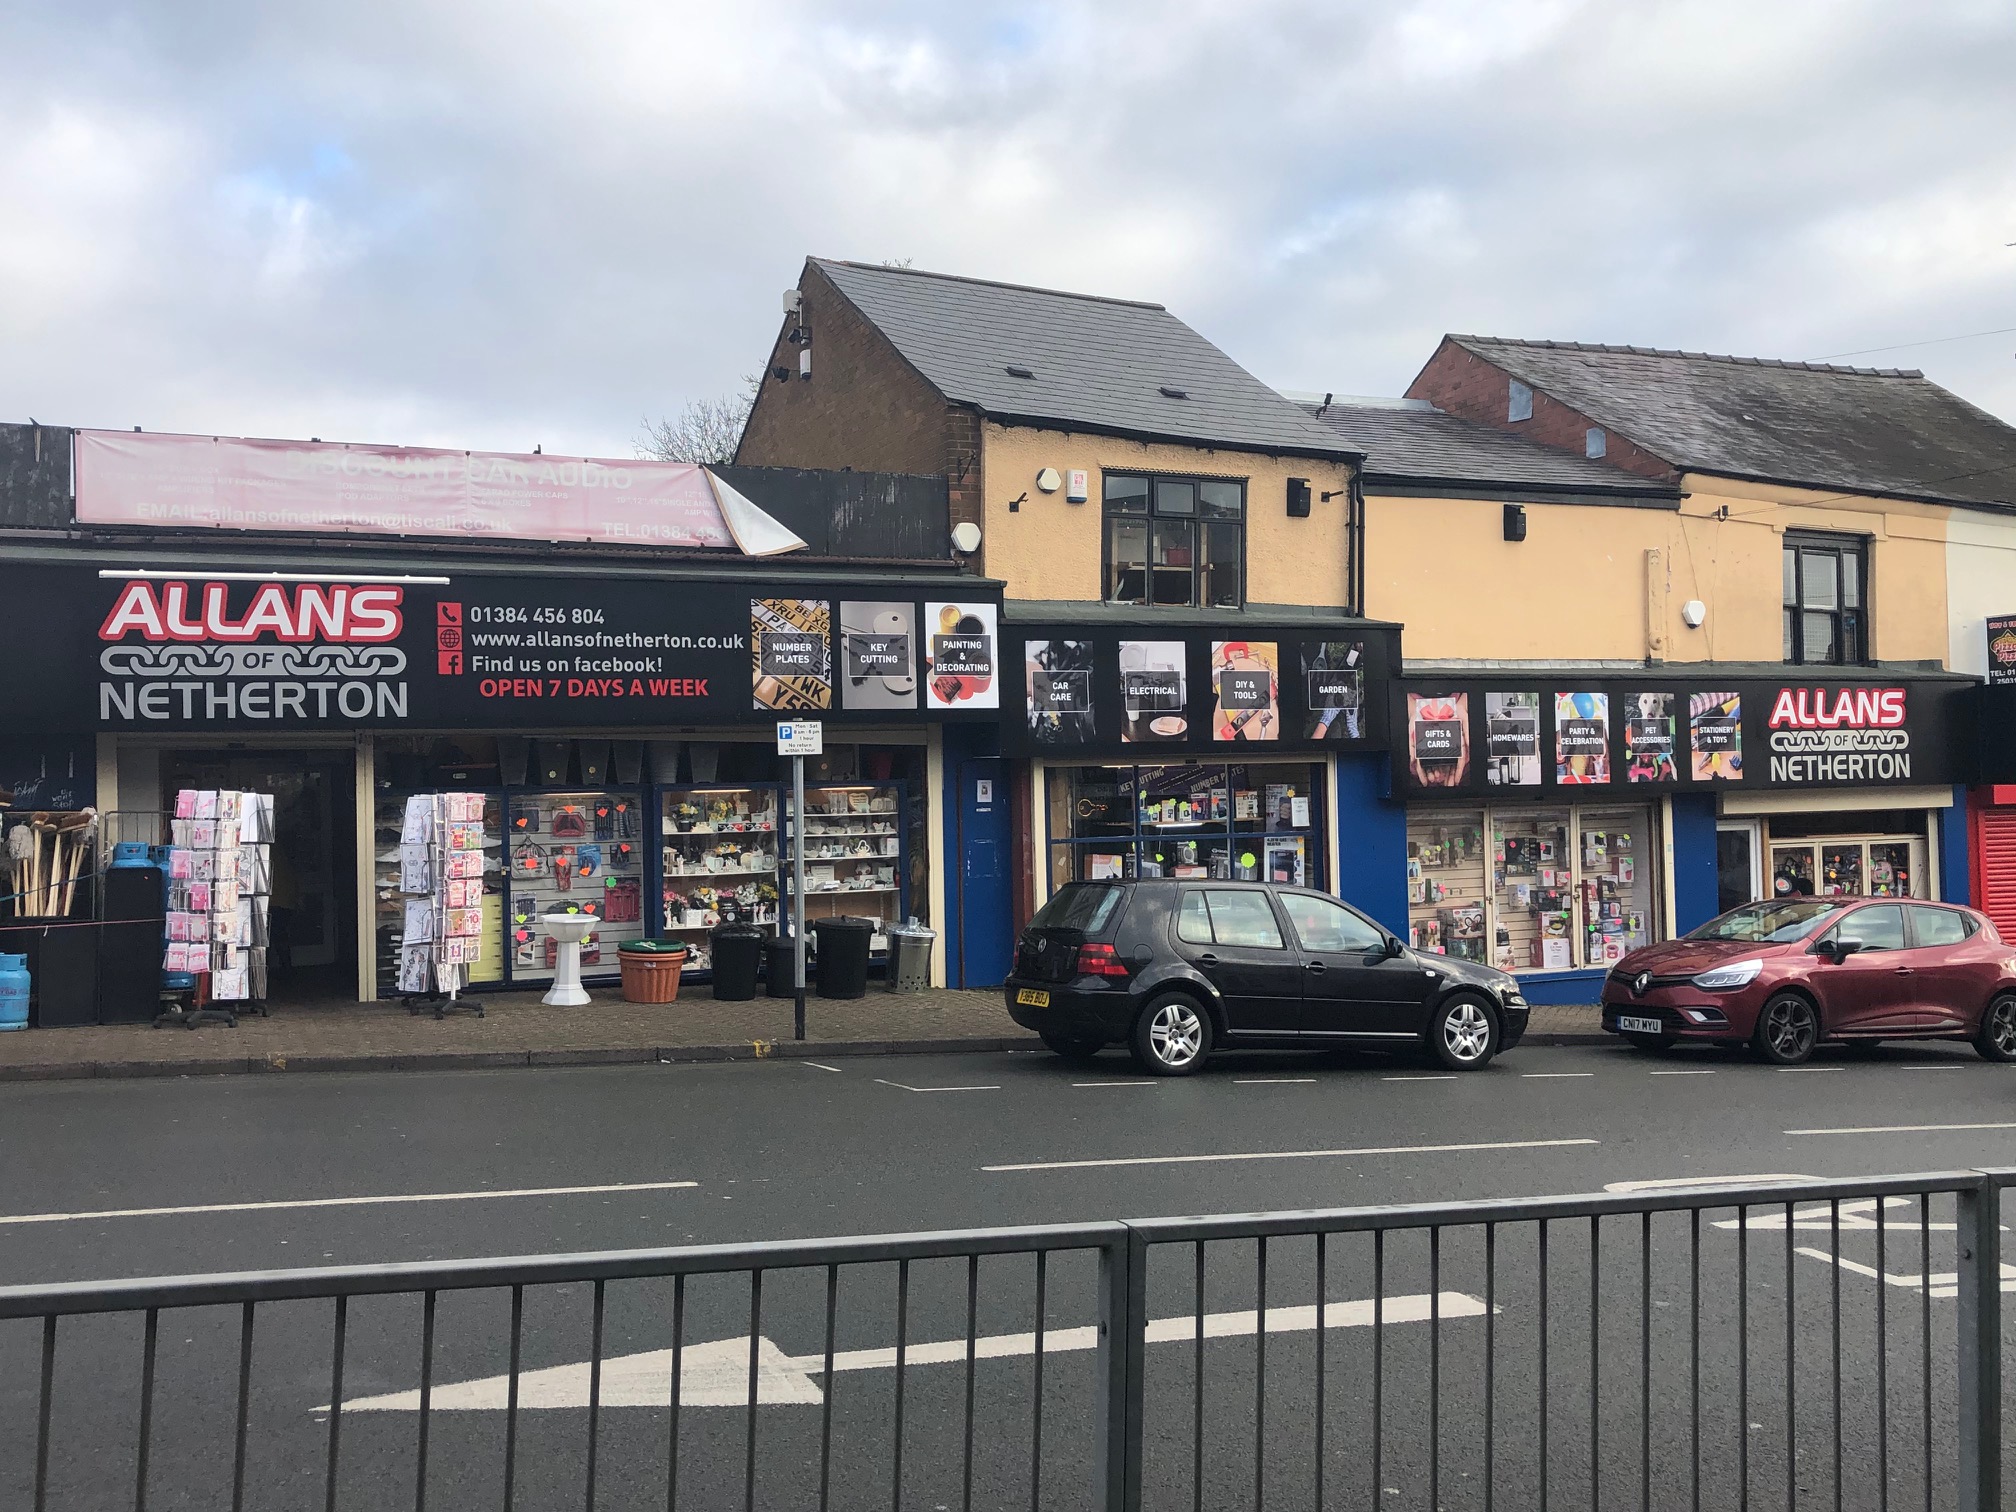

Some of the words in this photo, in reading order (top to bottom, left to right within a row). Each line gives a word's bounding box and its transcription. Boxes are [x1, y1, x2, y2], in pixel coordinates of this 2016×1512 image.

[468, 457, 529, 486] CAR
[538, 461, 633, 490] AUDIO
[545, 491, 570, 501] CAPS
[99, 581, 403, 642] ALLANS
[470, 606, 528, 623] 01384
[533, 607, 566, 624] 456
[572, 607, 605, 625] 804
[471, 631, 745, 650] www.allansofnetherton.co.uk
[942, 640, 982, 649] PAINTING
[772, 642, 812, 652] NUMBER
[870, 643, 888, 652] KEY
[242, 652, 275, 669] OF
[775, 654, 810, 664] PLATES
[860, 654, 898, 664] CUTTING
[959, 652, 966, 660] &
[472, 655, 514, 672] Find
[519, 660, 541, 672] us
[546, 660, 569, 673] on
[574, 656, 663, 673] facebook!
[936, 663, 990, 672] DECORATING
[479, 678, 542, 697] OPEN
[549, 679, 561, 696] 7
[568, 679, 624, 697] DAYS
[630, 679, 644, 696] A
[648, 679, 709, 696] WEEK
[1052, 681, 1069, 690] CAR
[1235, 681, 1247, 689] DIY
[1249, 681, 1255, 689] &
[1319, 686, 1348, 694] GARDEN
[1129, 686, 1178, 695] ELECTRICAL
[1233, 691, 1257, 699] TOOLS
[100, 681, 407, 720] NETHERTON
[1050, 693, 1072, 701] CARE
[1769, 688, 1906, 728] ALLANS
[782, 727, 790, 738] P
[1425, 730, 1445, 738] GIFTS
[1446, 730, 1452, 738] &
[1569, 727, 1589, 735] PARTY
[1590, 727, 1595, 735] &
[1699, 726, 1734, 734] STATIONERY
[1492, 734, 1534, 742] HOMEWARES
[1561, 737, 1604, 745] CELEBRATION
[1631, 736, 1671, 744] ACCESSORIES
[1713, 736, 1727, 744] TOYS
[1833, 735, 1849, 746] OF
[1427, 740, 1450, 748] CARDS
[1770, 753, 1911, 782] NETHERTON
[1119, 780, 1134, 793] KEY
[1138, 768, 1165, 784] UTTING
[1190, 774, 1220, 793] NUMBER
[1220, 765, 1245, 783] PTES
[1623, 1018, 1640, 1030] CN17
